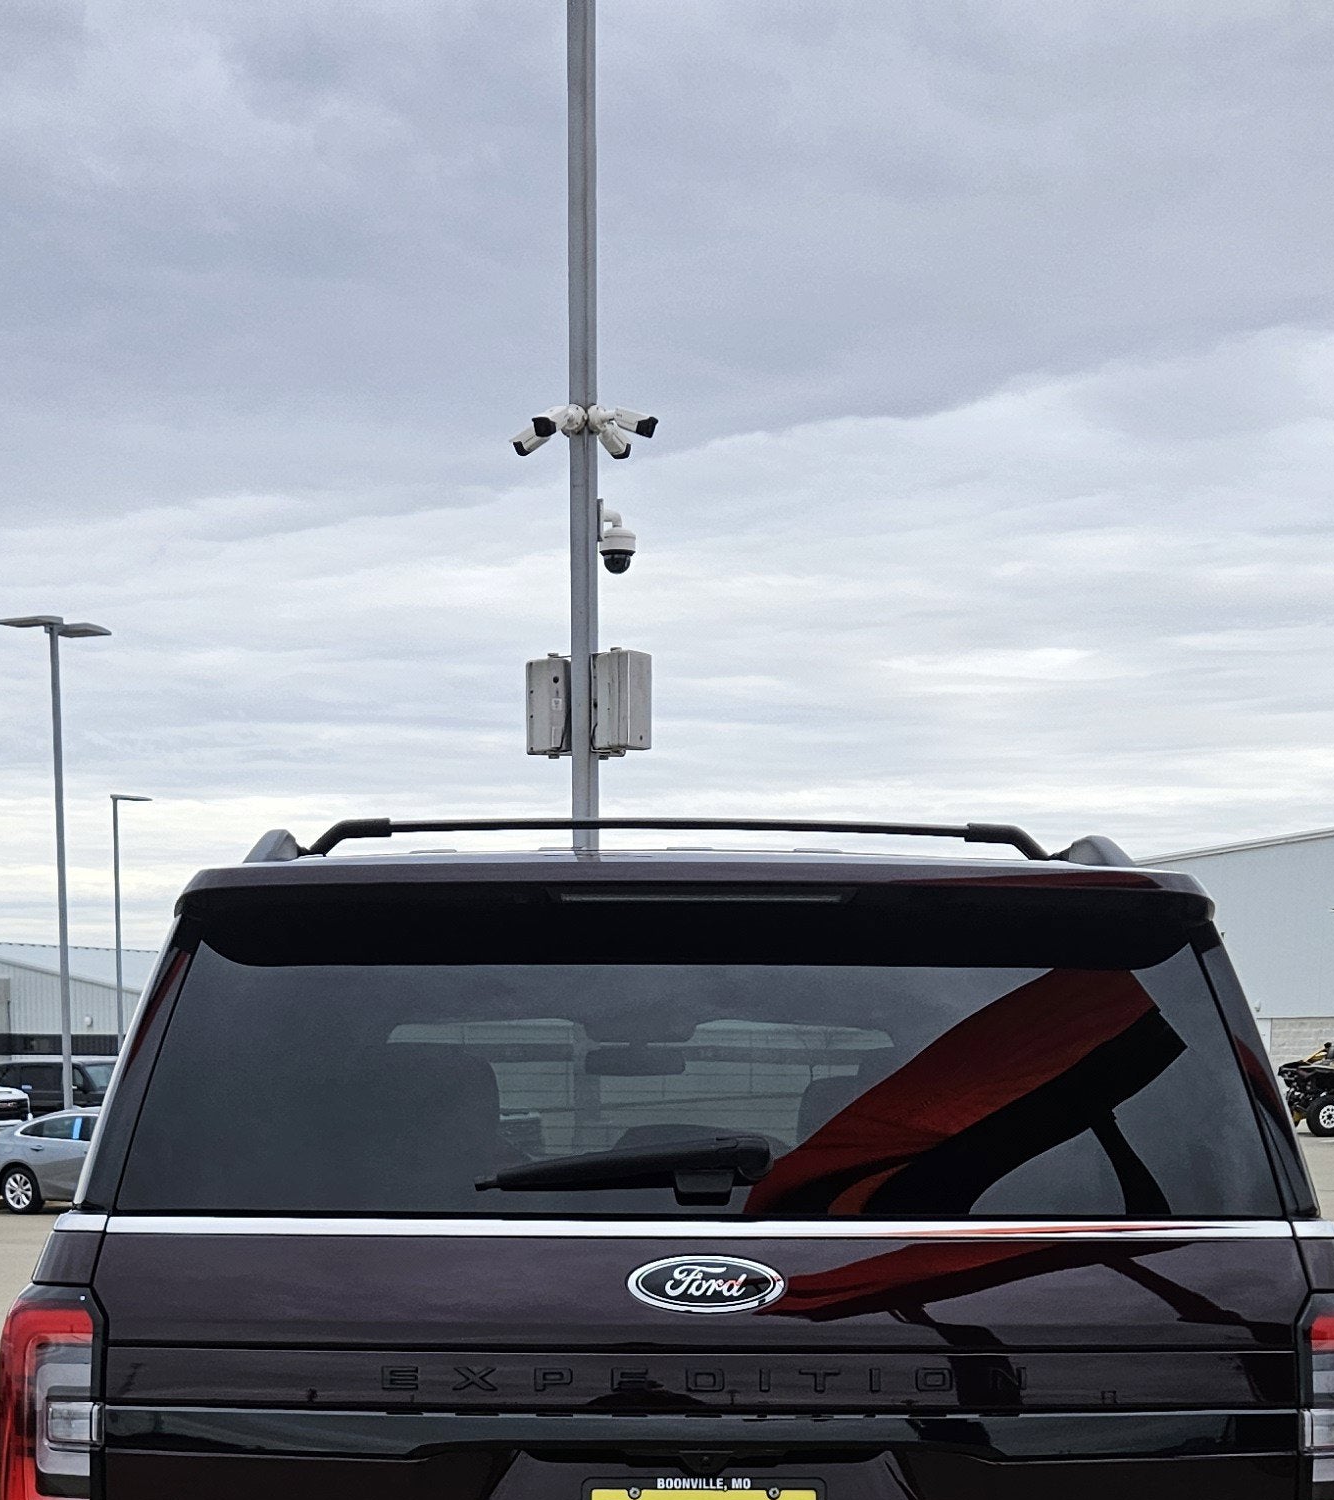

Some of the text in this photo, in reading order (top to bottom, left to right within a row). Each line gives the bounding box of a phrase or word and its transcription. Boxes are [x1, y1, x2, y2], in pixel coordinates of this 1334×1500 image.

[665, 1265, 748, 1297] Ford
[381, 1365, 1027, 1393] EXPEDITION
[657, 1478, 751, 1491] BOONVILLE, MO
